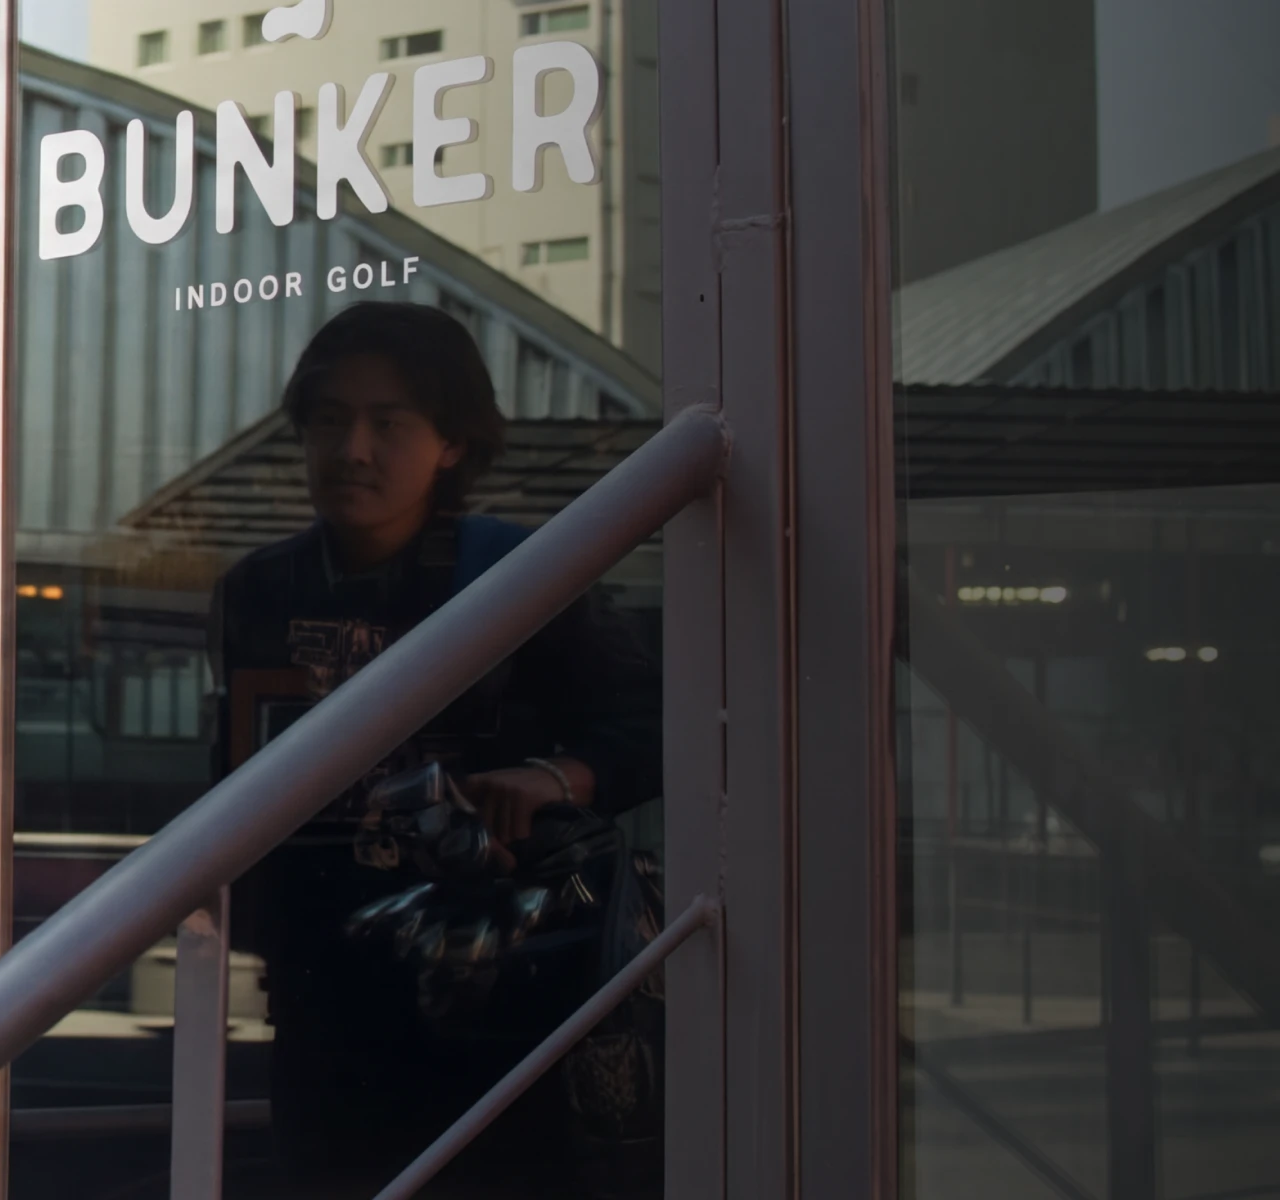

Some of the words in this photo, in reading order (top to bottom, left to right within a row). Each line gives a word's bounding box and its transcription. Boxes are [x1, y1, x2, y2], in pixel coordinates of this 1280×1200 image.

[37, 40, 603, 260] BUNKER
[175, 271, 303, 311] INDOOR
[327, 256, 420, 293] GOLF
